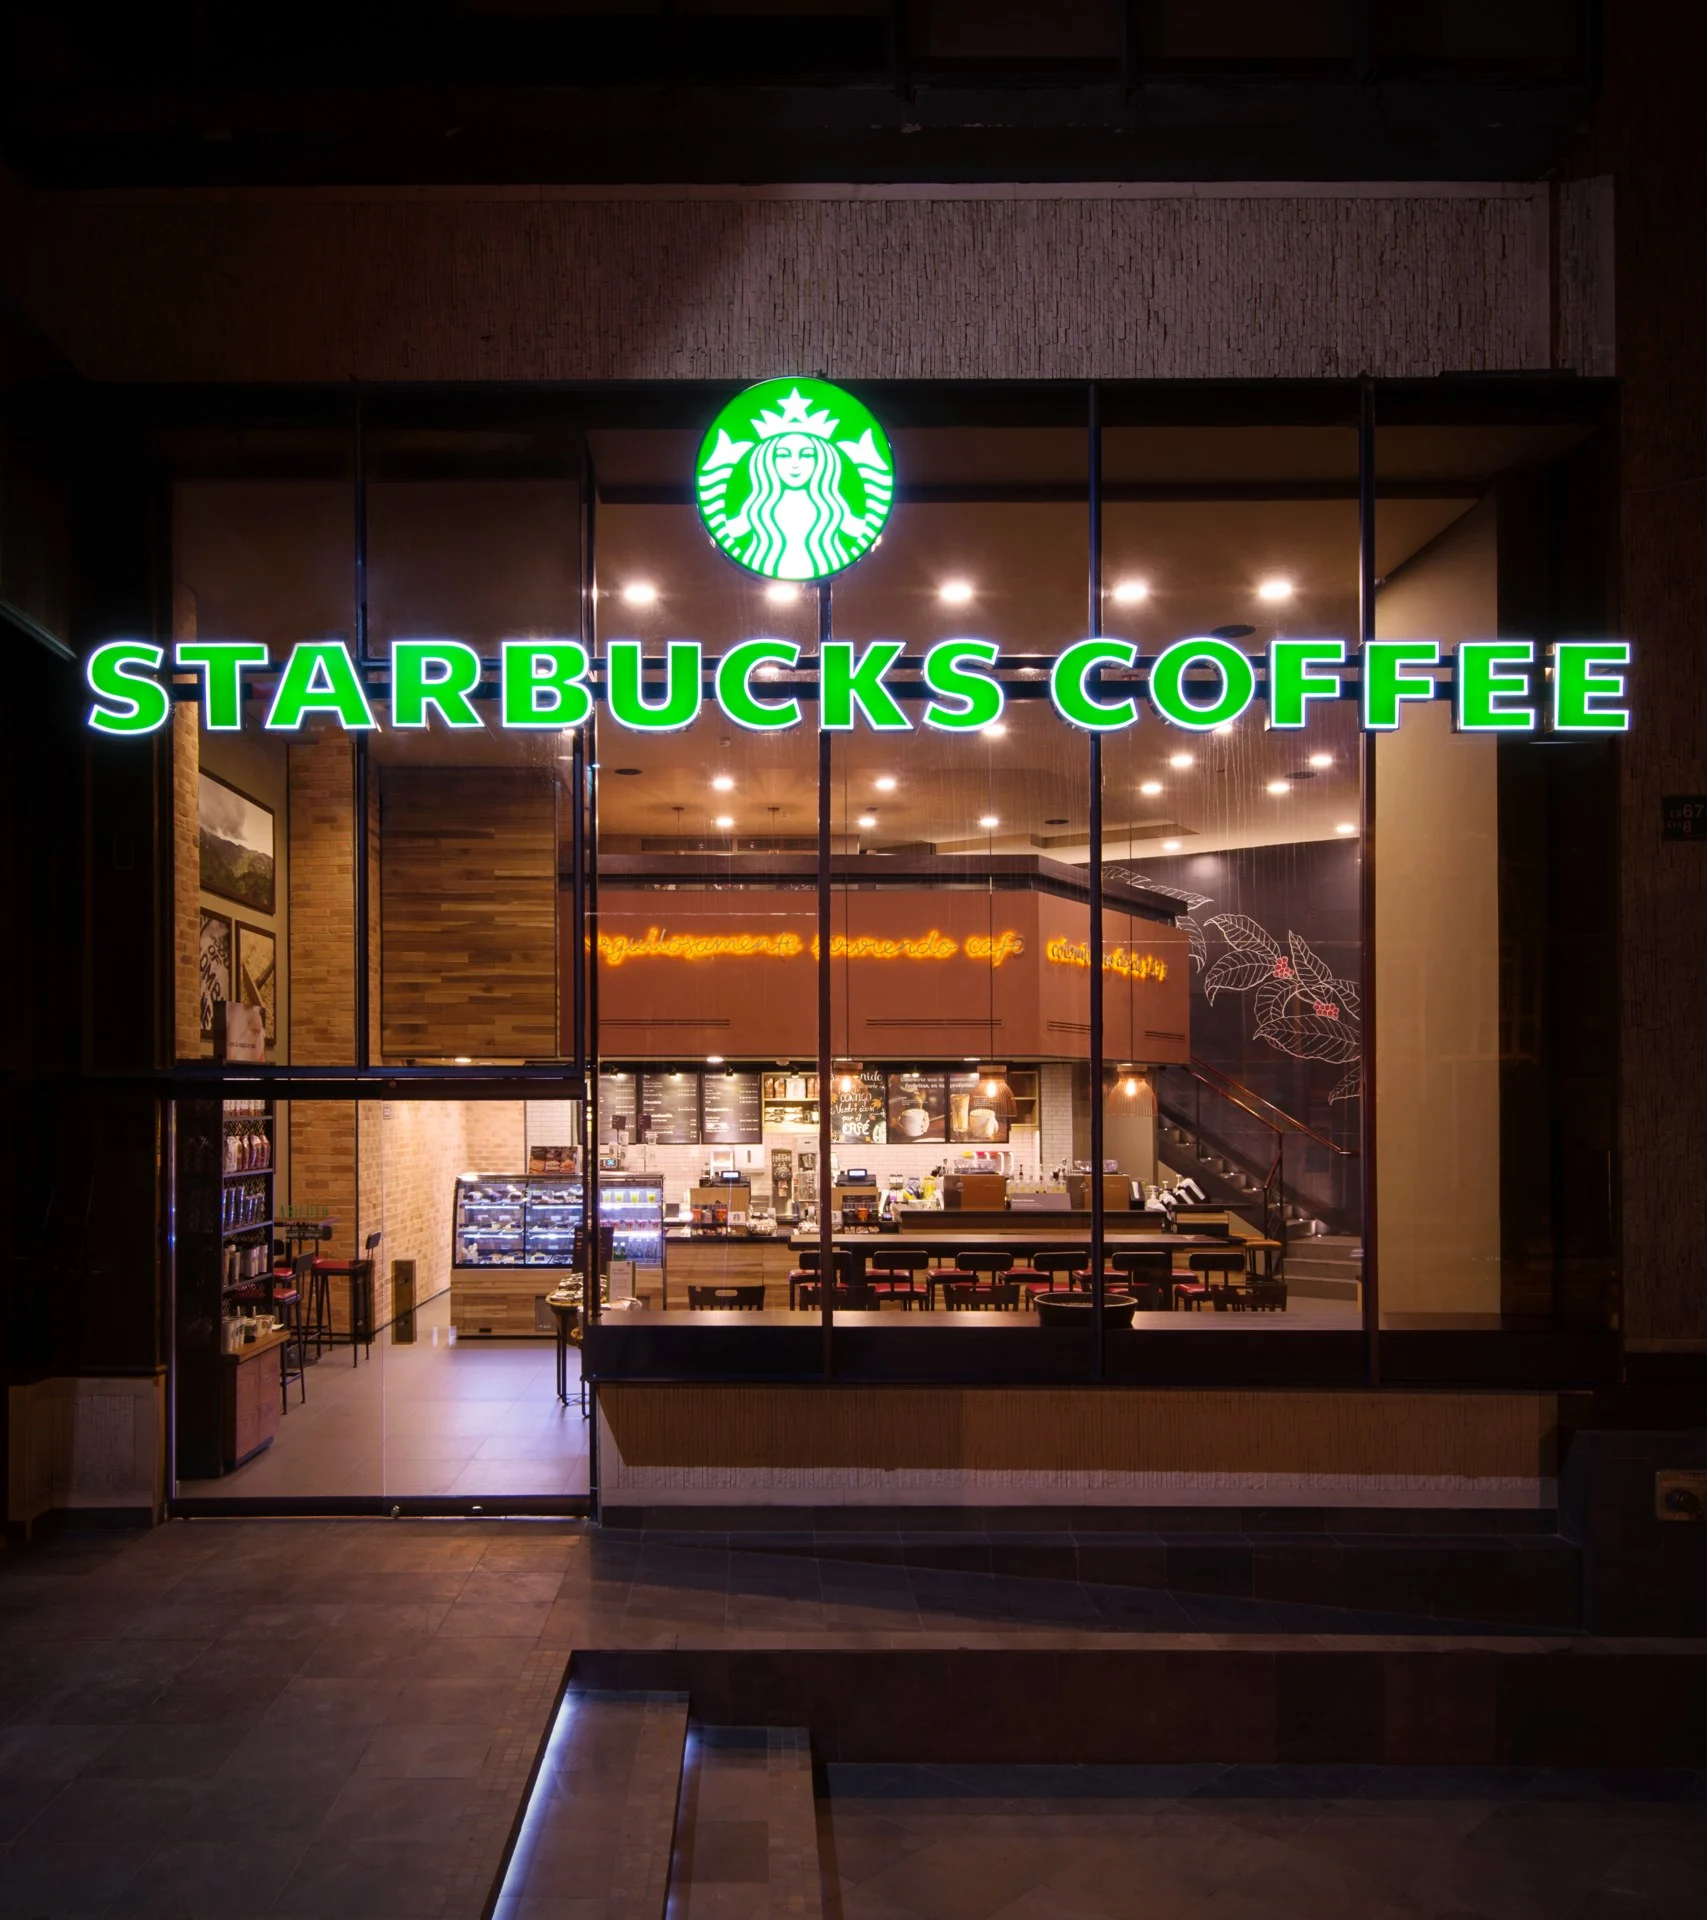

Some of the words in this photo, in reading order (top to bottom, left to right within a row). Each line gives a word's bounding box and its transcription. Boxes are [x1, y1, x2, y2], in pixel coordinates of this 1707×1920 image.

[87, 639, 1004, 734] STARBUCKS
[1051, 637, 1632, 732] COFFEE
[1683, 804, 1705, 818] 67
[1682, 820, 1692, 833] 8
[585, 928, 802, 965] rgullosamente
[841, 1119, 870, 1136] CAFÉ
